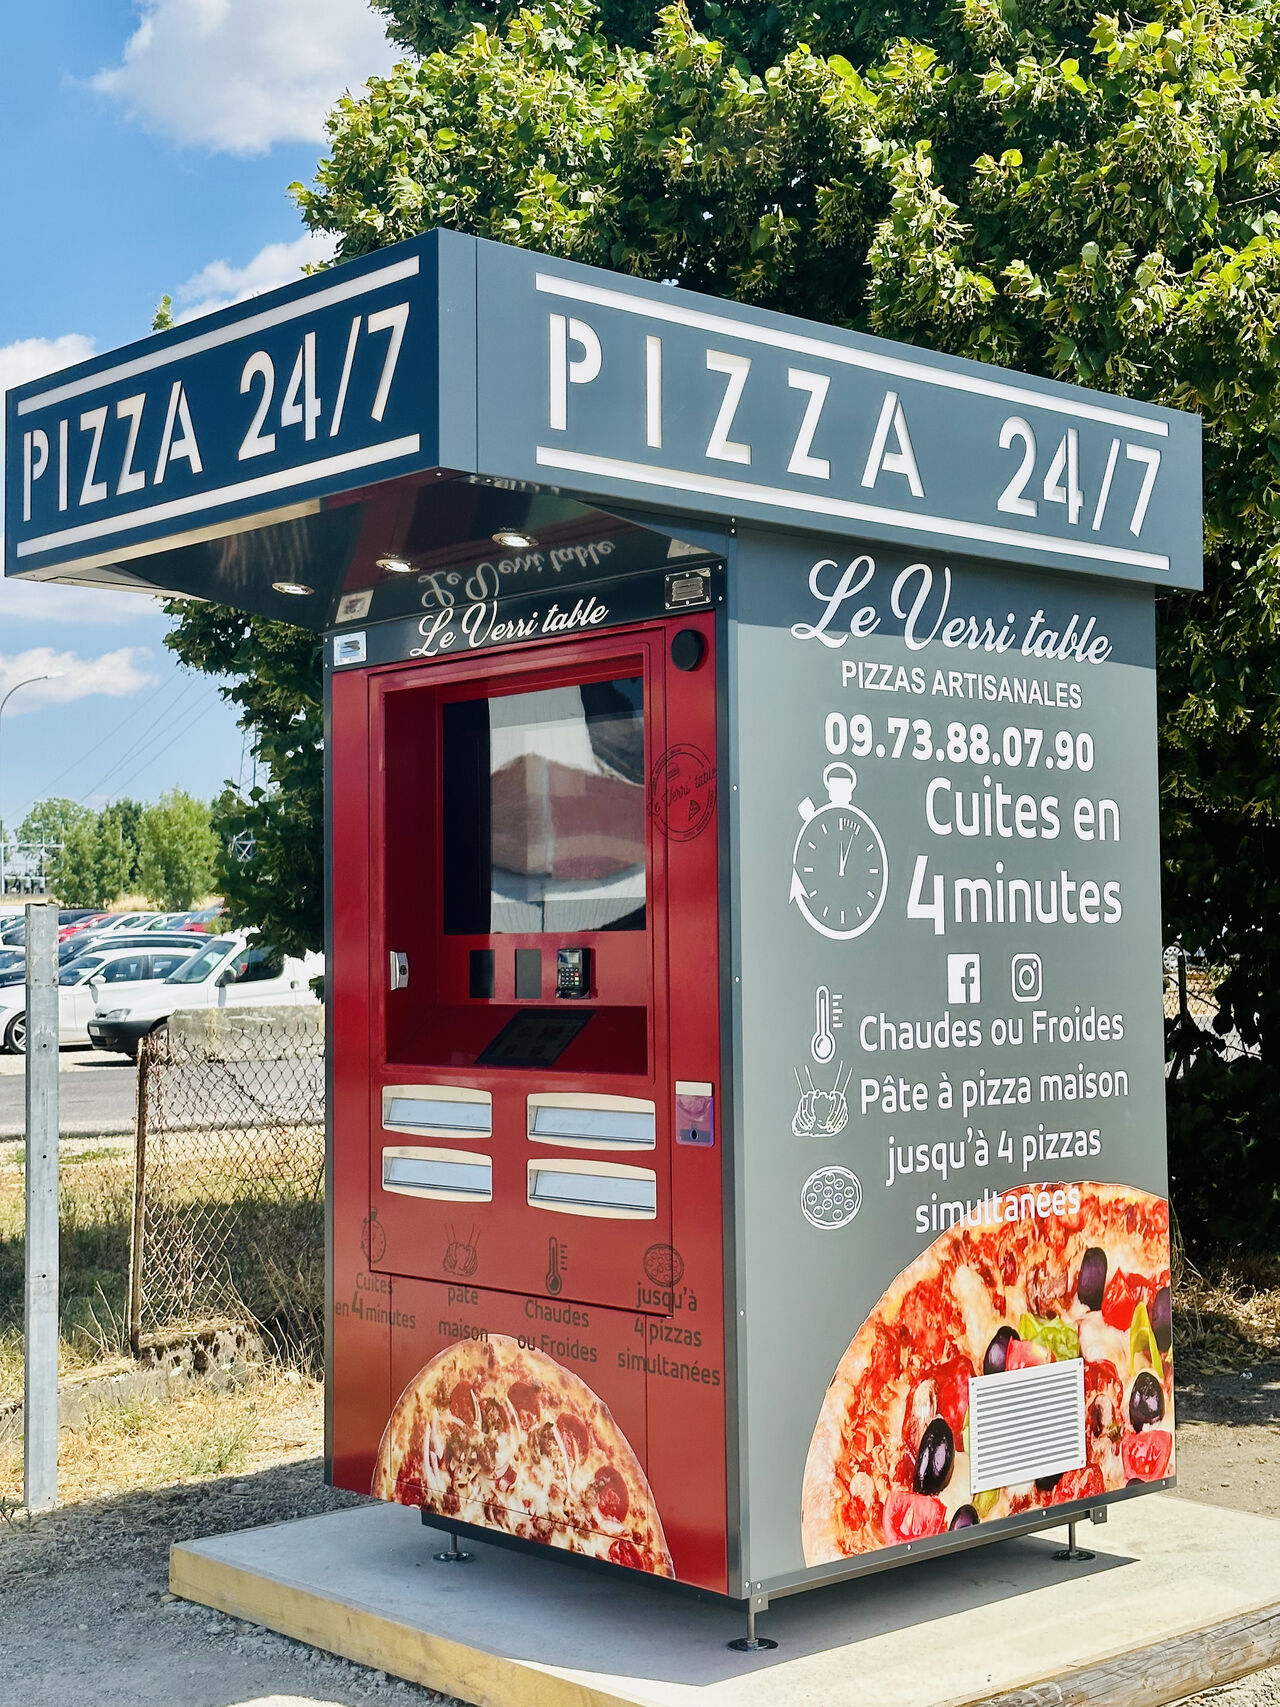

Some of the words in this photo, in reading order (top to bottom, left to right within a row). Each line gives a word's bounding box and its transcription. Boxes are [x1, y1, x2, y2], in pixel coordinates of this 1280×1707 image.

[23, 380, 203, 522] PIZZA
[238, 302, 410, 461] 24/7
[549, 314, 925, 498] PIZZA
[997, 416, 1162, 538] 24/7
[410, 608, 456, 657] Le
[461, 600, 539, 648] Verri
[541, 597, 609, 633] table
[790, 555, 881, 649] Le
[890, 563, 1016, 654] Verri
[1021, 609, 1113, 665] table
[841, 660, 926, 695] PIZZAS
[932, 669, 1082, 709] ARTISANALES
[824, 712, 1095, 772] 09.73.88.07.90
[925, 775, 1061, 840] Cuites
[1074, 798, 1120, 841] en
[907, 855, 945, 935] 4
[954, 861, 1123, 924] minutes
[859, 1011, 982, 1051] Chaudes
[990, 1017, 1023, 1046] ou
[1032, 1005, 1125, 1044] Froides
[860, 1075, 928, 1115] Pâte
[938, 1072, 952, 1110] à
[962, 1069, 1031, 1118] pizza
[1040, 1063, 1129, 1101] maison
[885, 1127, 989, 1187] jusqu'à
[998, 1130, 1013, 1163] 4
[1022, 1123, 1101, 1172] pizzas
[915, 1182, 1081, 1233] simultanées
[355, 1271, 393, 1295] Cuites
[636, 1281, 697, 1314] jusqu'à
[335, 1302, 349, 1317] en
[351, 1290, 364, 1320] 4
[366, 1304, 416, 1329] minutes
[438, 1317, 488, 1343] maison
[525, 1298, 589, 1328] Chaudes
[634, 1317, 644, 1337] 4
[649, 1319, 702, 1347] pizzas
[517, 1334, 536, 1351] ou
[541, 1334, 598, 1362] Froides
[617, 1347, 721, 1386] simultanées
